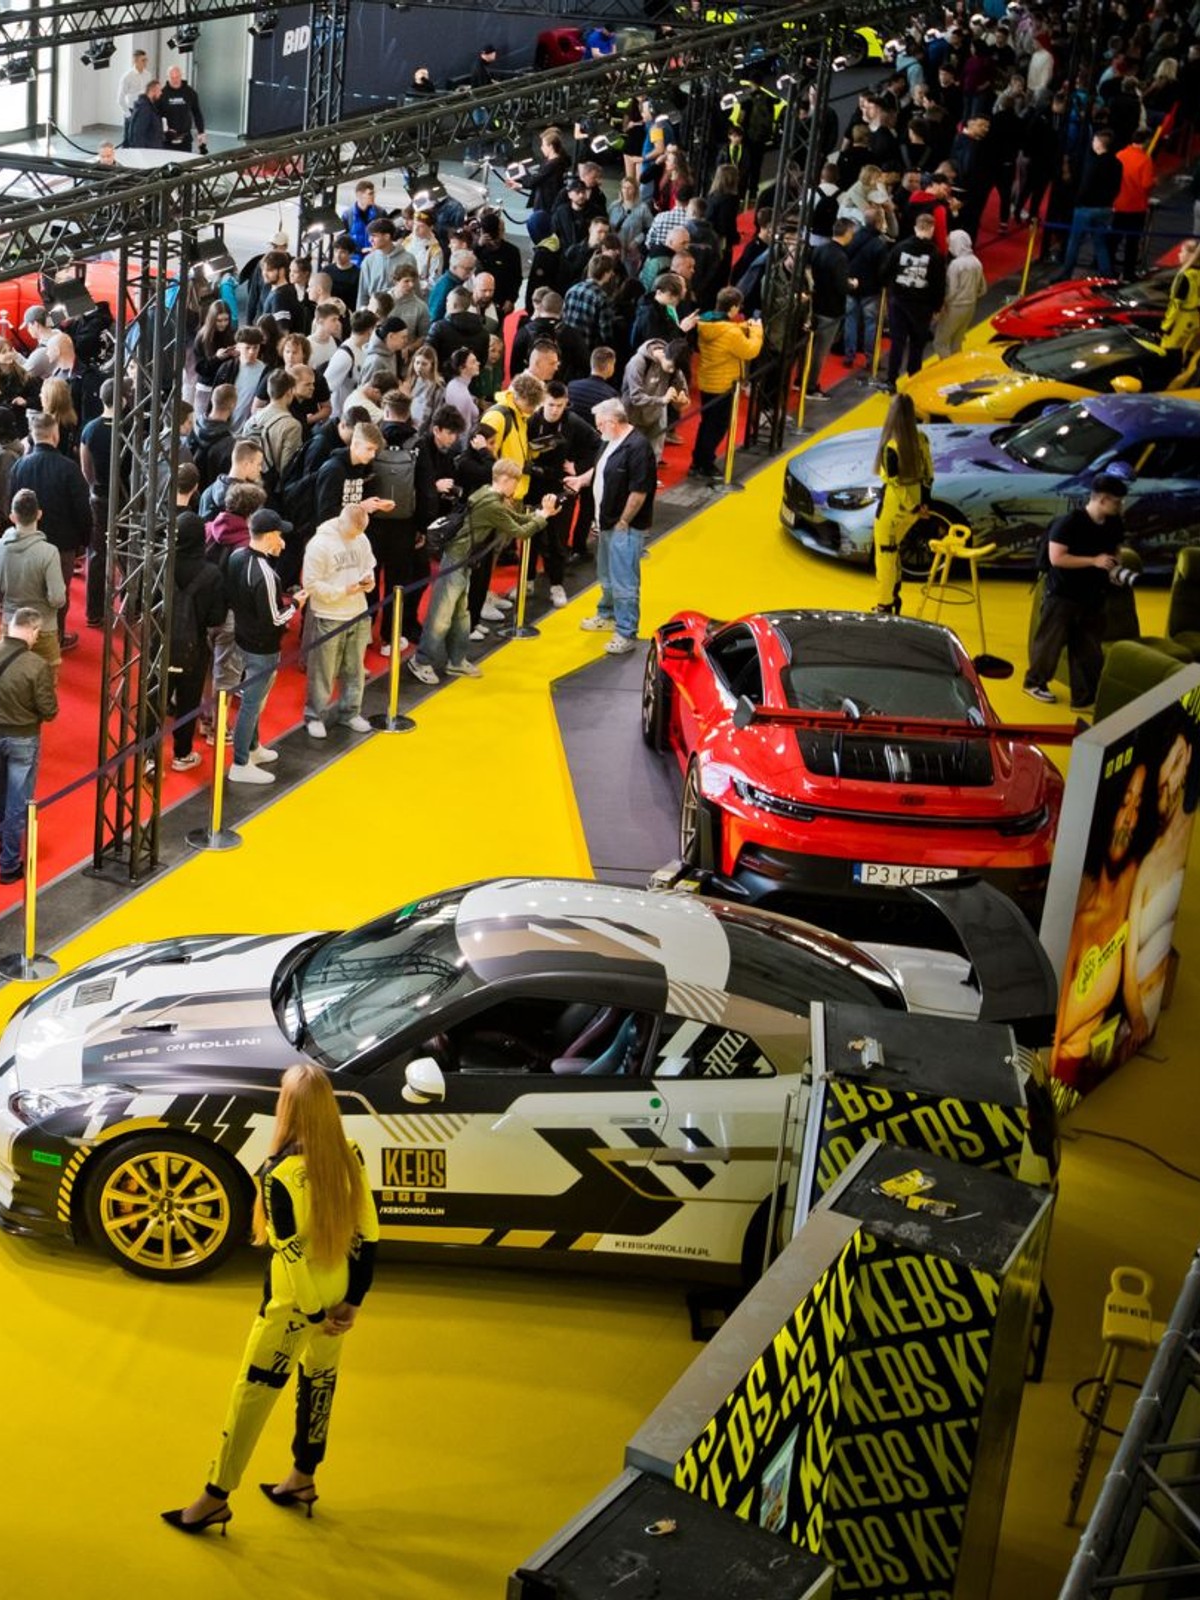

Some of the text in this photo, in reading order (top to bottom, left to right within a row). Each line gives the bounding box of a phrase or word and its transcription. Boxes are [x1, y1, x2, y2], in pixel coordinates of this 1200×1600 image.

[867, 865, 890, 884] P3
[166, 1042, 185, 1052] ON
[384, 1149, 444, 1187] KEBS
[855, 1255, 973, 1339] KEBS
[841, 1341, 950, 1421] KEBS
